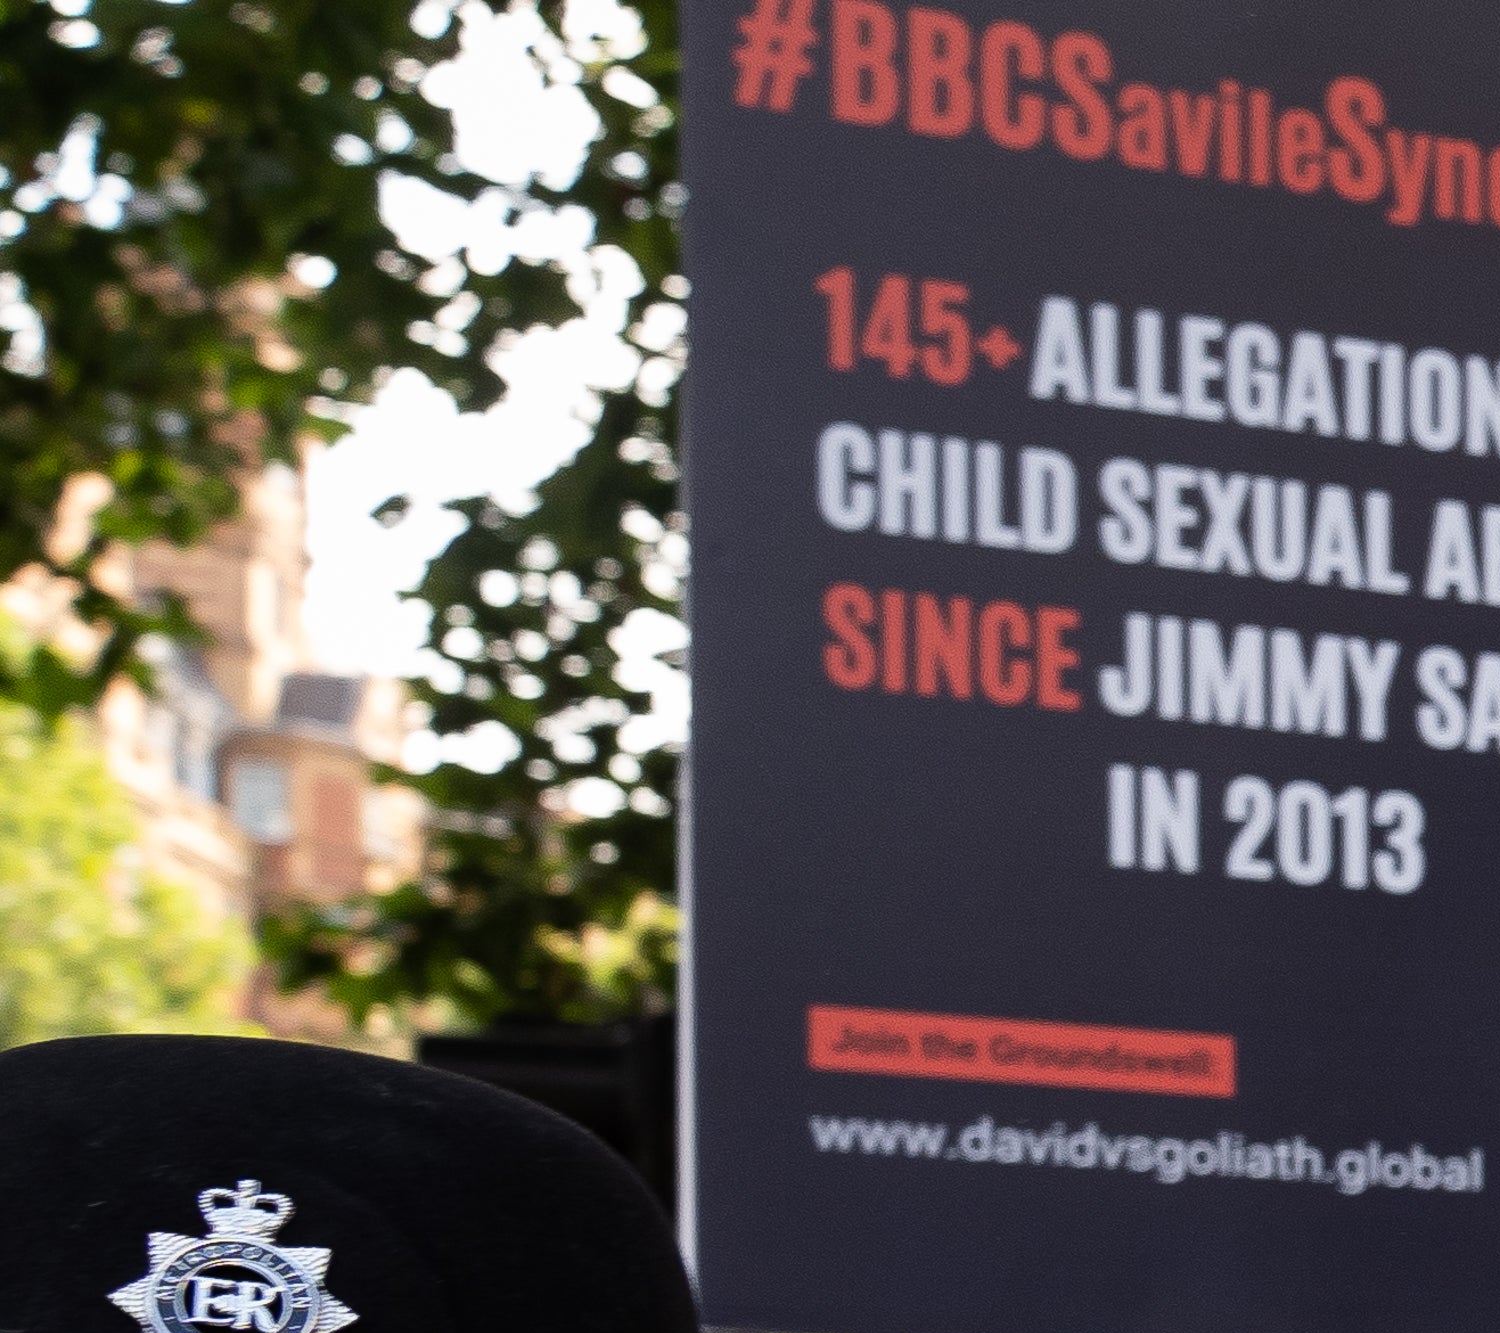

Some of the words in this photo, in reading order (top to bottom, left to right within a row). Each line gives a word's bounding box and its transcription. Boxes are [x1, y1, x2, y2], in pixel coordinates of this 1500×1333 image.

[814, 266, 1021, 385] 145+
[817, 422, 1078, 553] CHILD
[1098, 457, 1408, 595] SEXUAL
[822, 583, 1080, 712] SINCE
[1098, 613, 1402, 740] JIMMY
[1106, 764, 1198, 875] IN
[1224, 776, 1426, 895] 2013
[832, 1026, 911, 1056] Join
[919, 1029, 977, 1061] the
[809, 1114, 1483, 1194] www.davidvsgoliath.global
